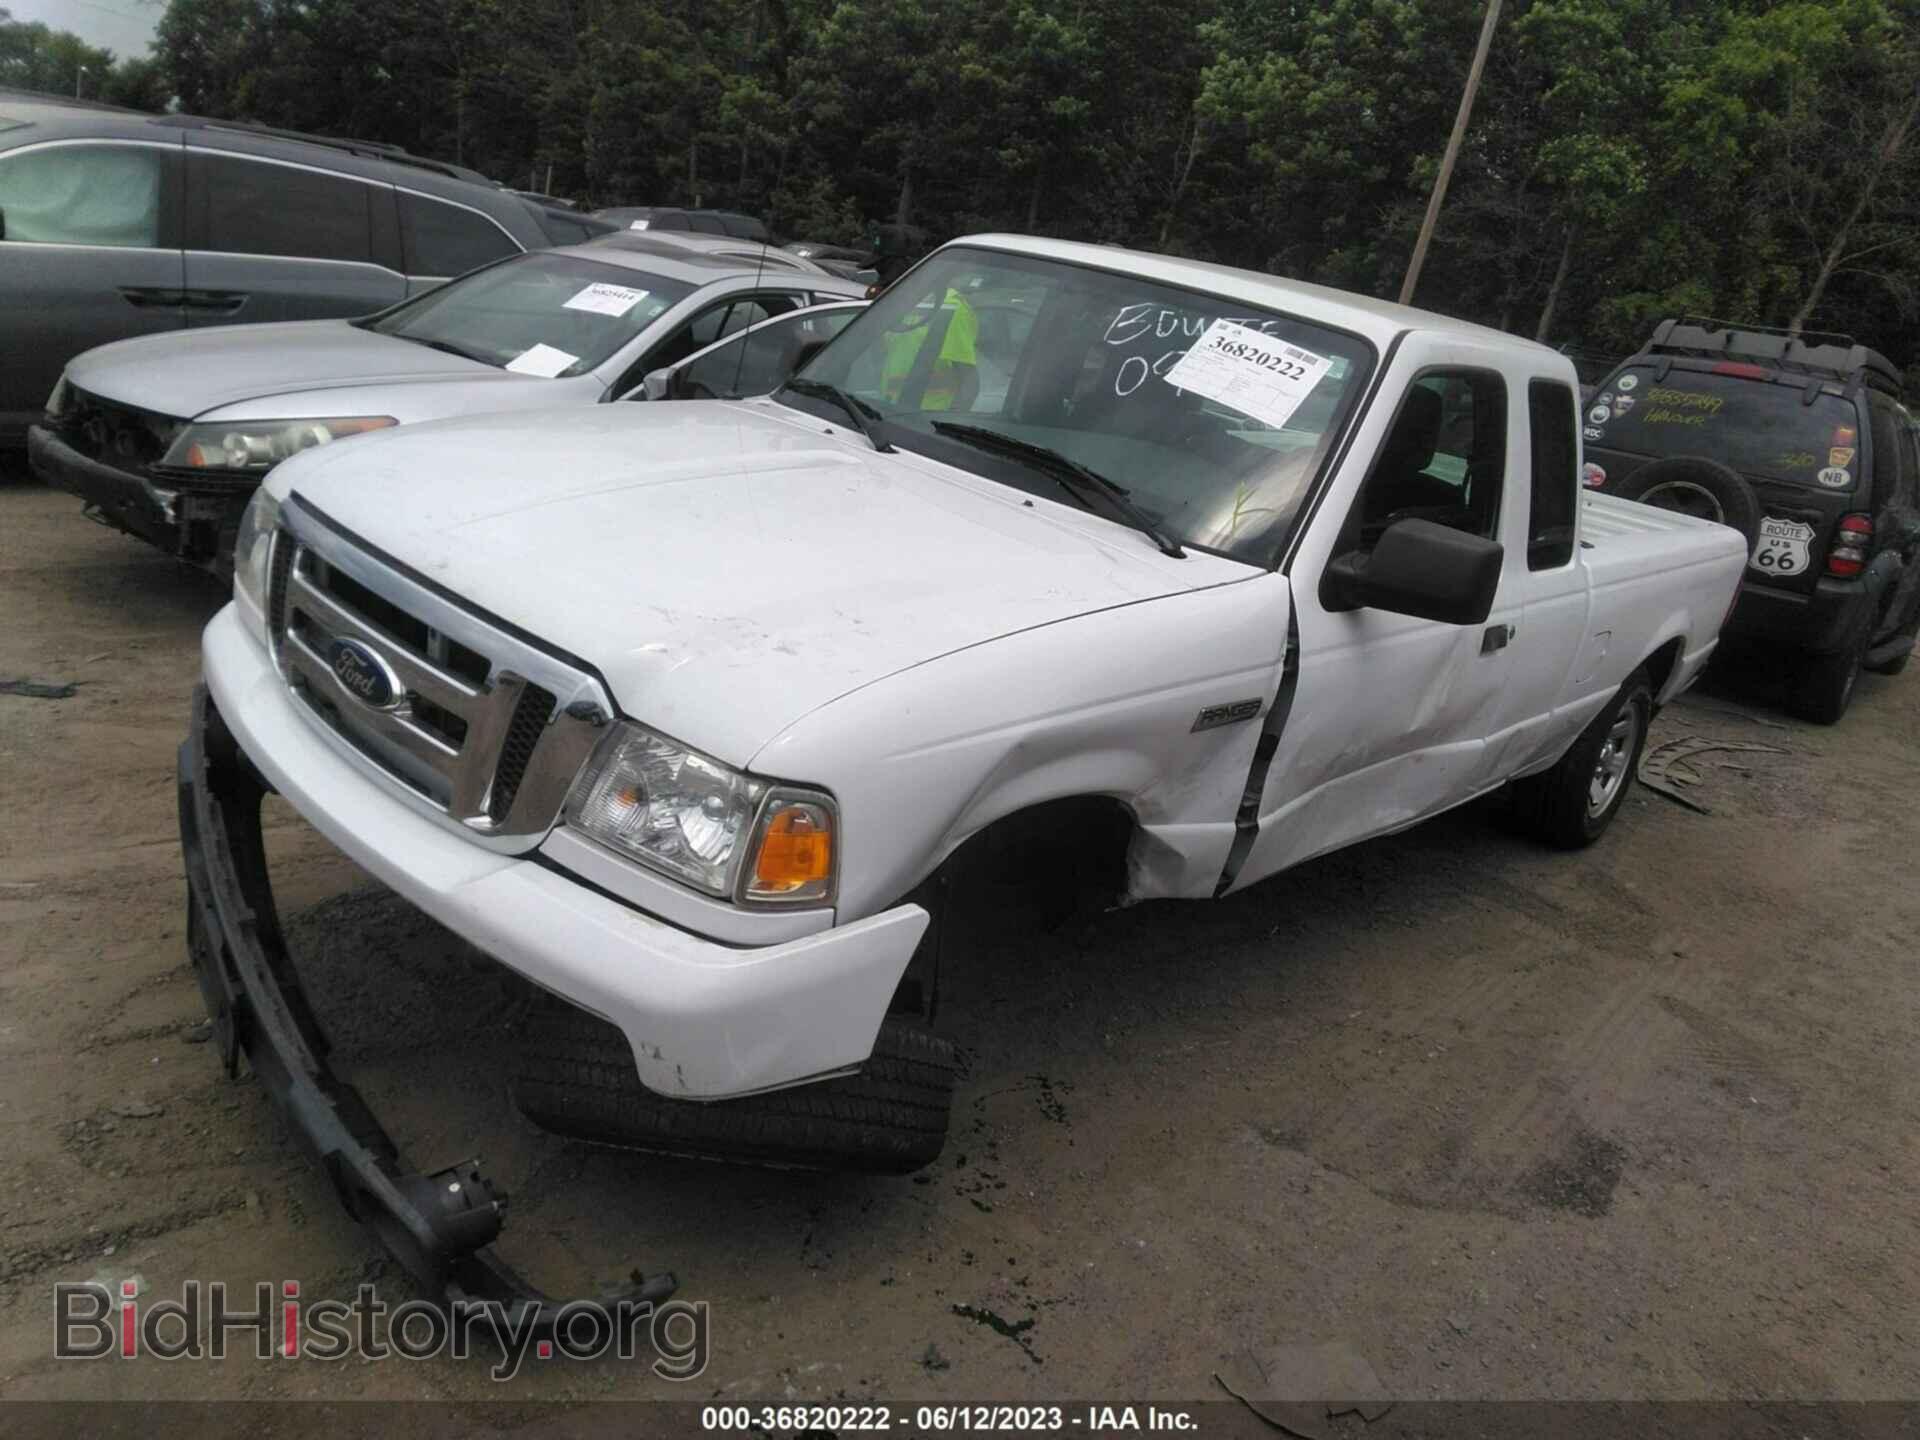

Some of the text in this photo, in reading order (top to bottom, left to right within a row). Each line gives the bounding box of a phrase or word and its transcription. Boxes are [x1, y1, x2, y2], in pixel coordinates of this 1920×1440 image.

[1208, 335, 1306, 381] 36820222
[1823, 471, 1842, 483] NB
[1766, 524, 1802, 538] ROUTE
[1758, 548, 1795, 571] 66
[335, 648, 378, 696] Ford
